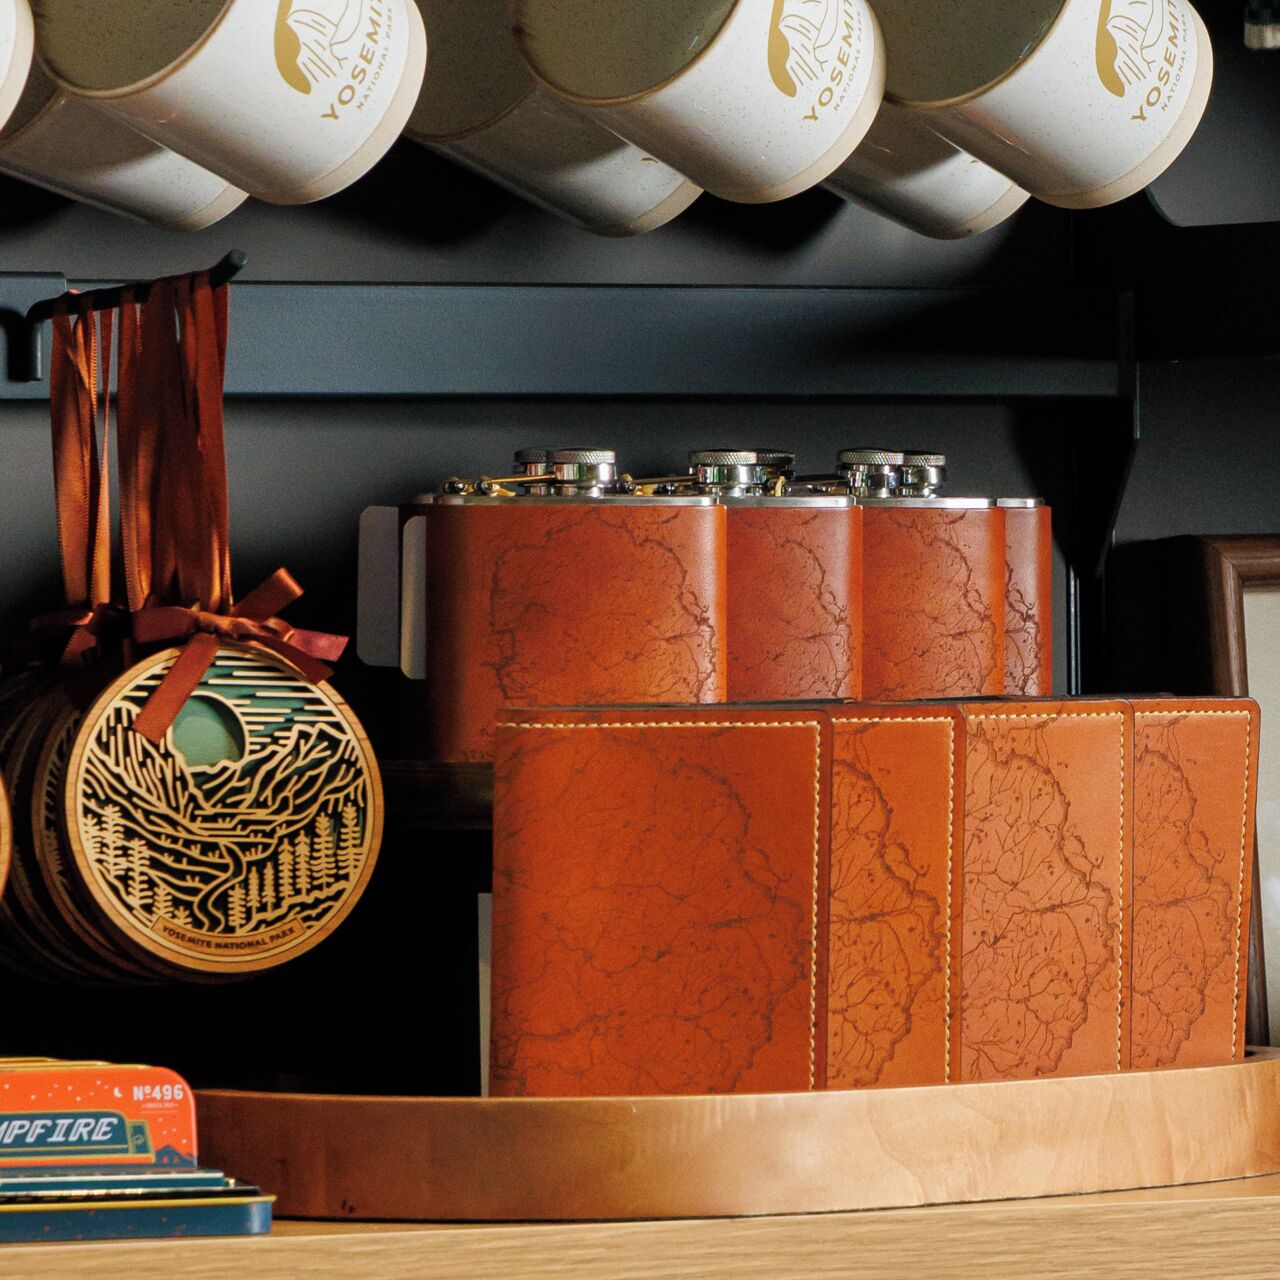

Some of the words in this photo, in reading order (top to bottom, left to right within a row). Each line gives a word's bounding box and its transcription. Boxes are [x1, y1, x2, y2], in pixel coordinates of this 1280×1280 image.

[355, 47, 391, 111] NATIONAL
[833, 47, 862, 113] NATIONAL
[1160, 48, 1188, 112] NATIONAL
[162, 924, 213, 949] YOSEMITE
[213, 937, 269, 951] NATIONAL
[268, 926, 297, 944] PARK
